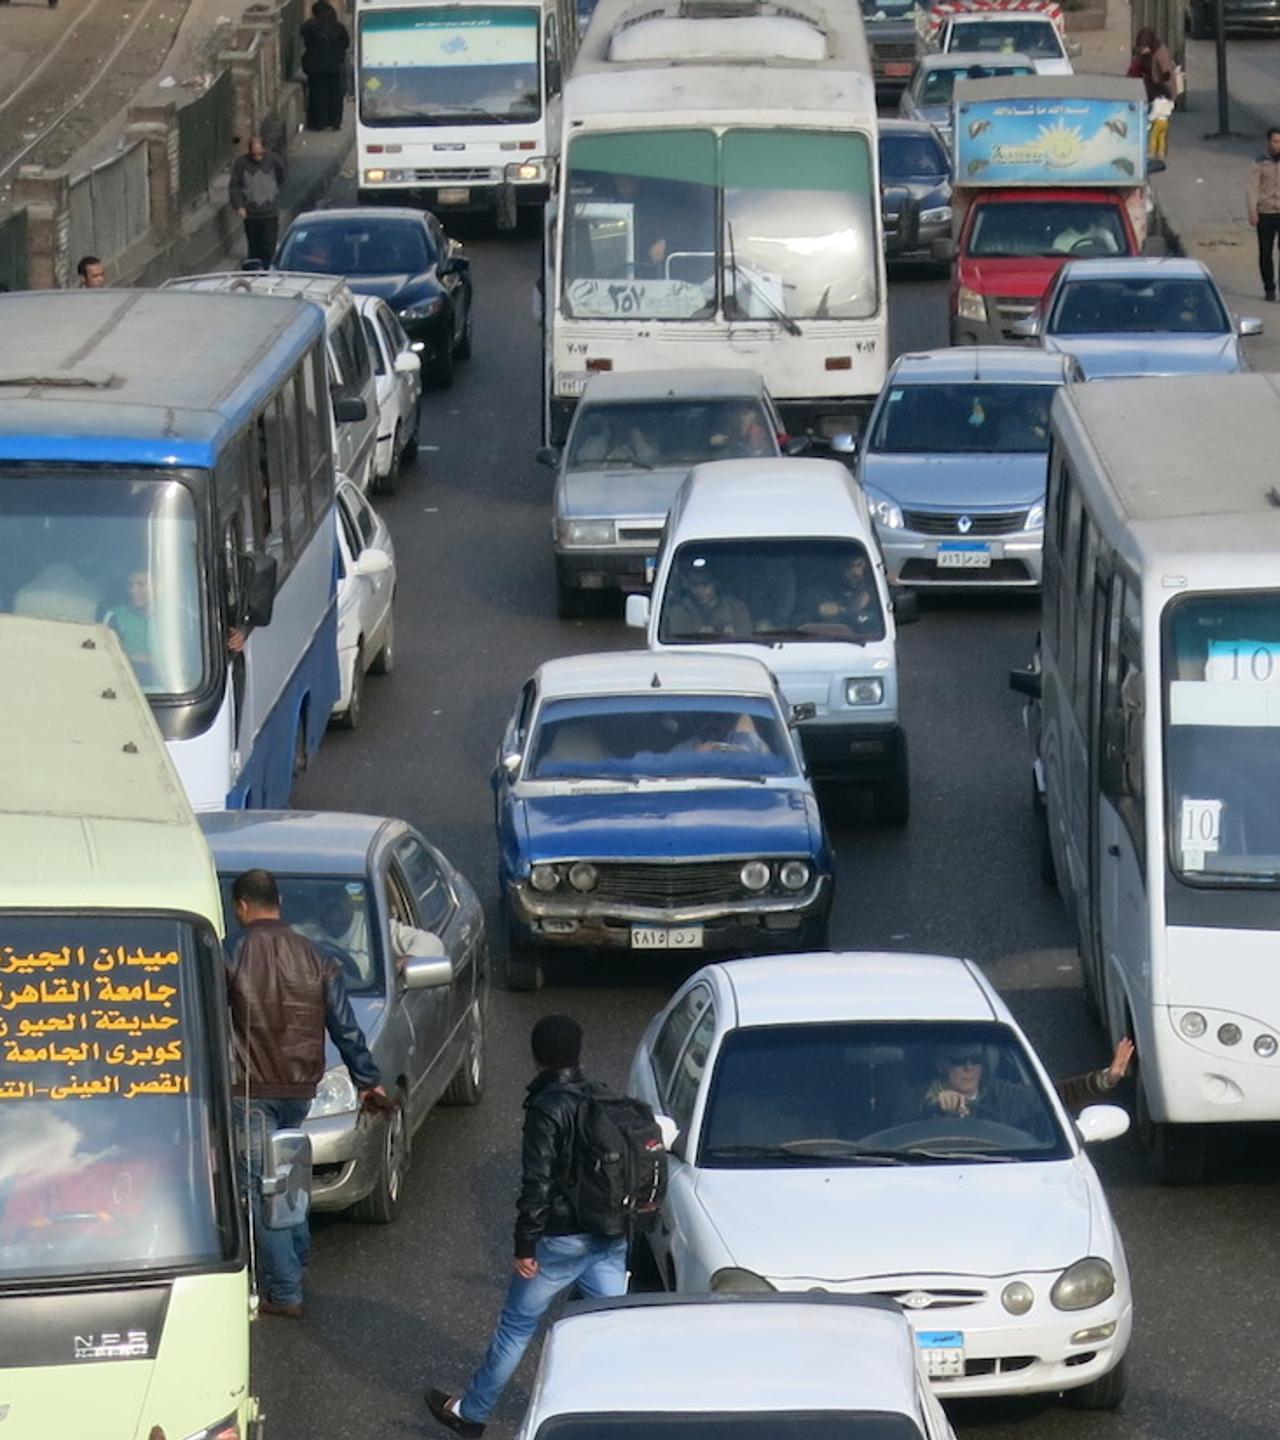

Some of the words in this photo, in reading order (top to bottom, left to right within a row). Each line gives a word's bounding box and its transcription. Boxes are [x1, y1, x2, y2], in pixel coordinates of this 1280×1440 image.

[1229, 646, 1274, 682] 10
[1187, 809, 1214, 841] 10
[92, 946, 181, 972] ميدان
[96, 977, 177, 1008] جامعة
[92, 1009, 180, 1037] حديقة
[4, 1040, 102, 1064] الجامعة
[104, 1040, 184, 1066] كوبرى
[125, 1072, 191, 1098] القصر
